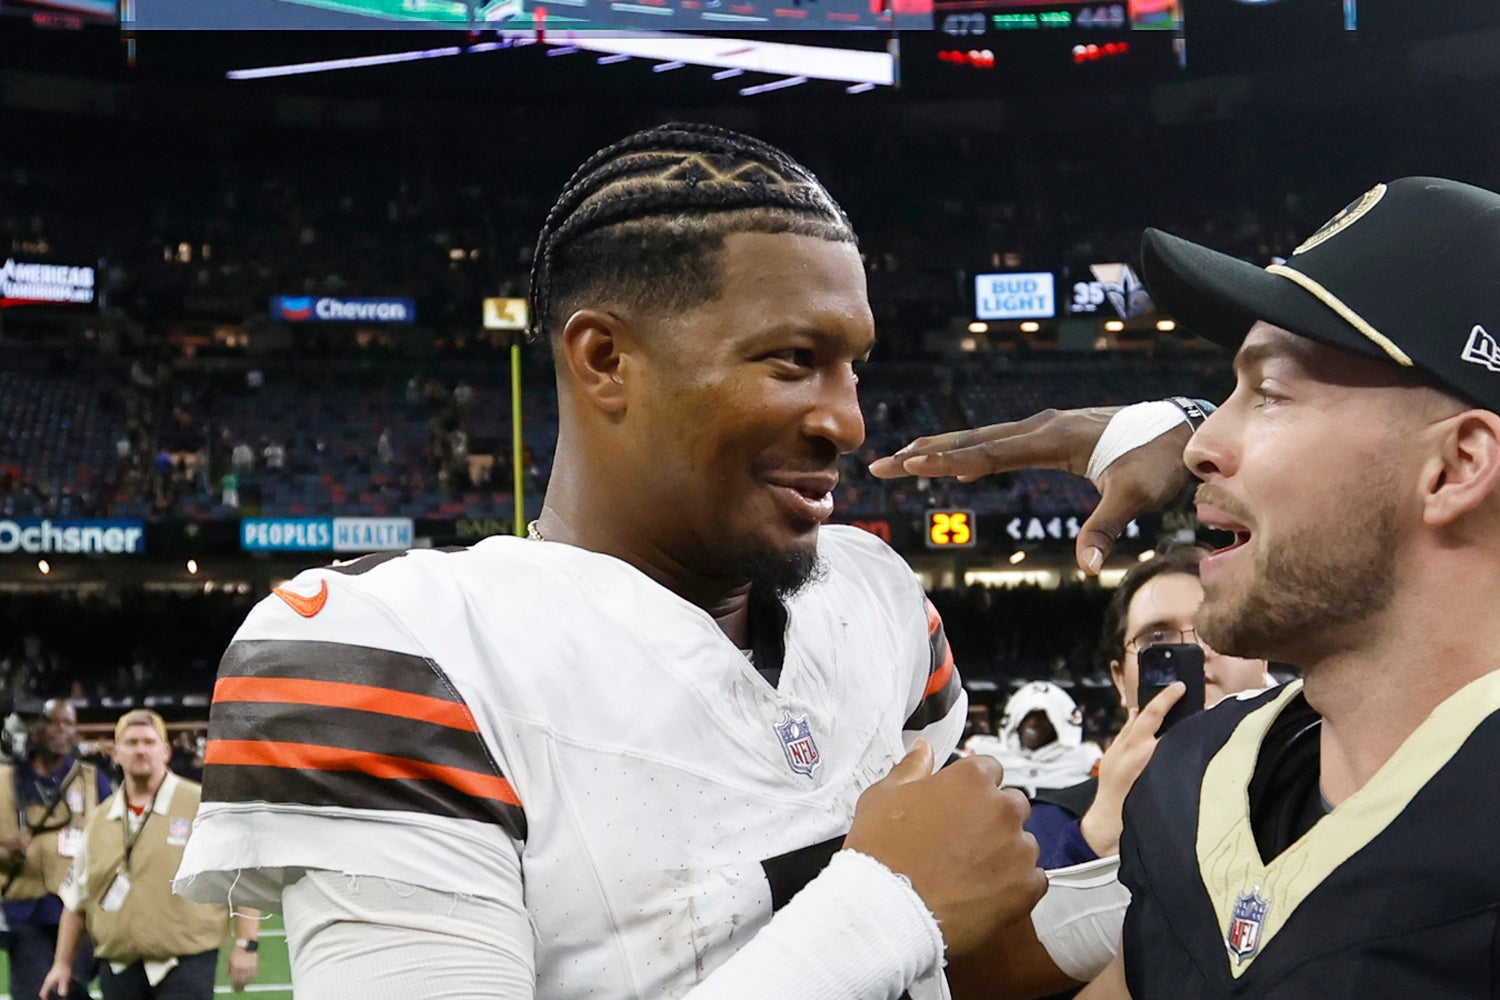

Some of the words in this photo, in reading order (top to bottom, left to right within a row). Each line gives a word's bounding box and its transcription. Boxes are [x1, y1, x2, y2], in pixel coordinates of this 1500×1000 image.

[991, 279, 1038, 294] BUD
[1073, 281, 1105, 305] 35
[316, 297, 407, 321] Chevron
[982, 296, 1047, 312] LIGHT
[0, 520, 143, 554] Ochsner
[244, 522, 331, 547] PEOPLES
[337, 524, 410, 545] HEALTH
[930, 512, 971, 545] 25
[788, 739, 818, 766] NFL
[1230, 918, 1256, 950] NFL
